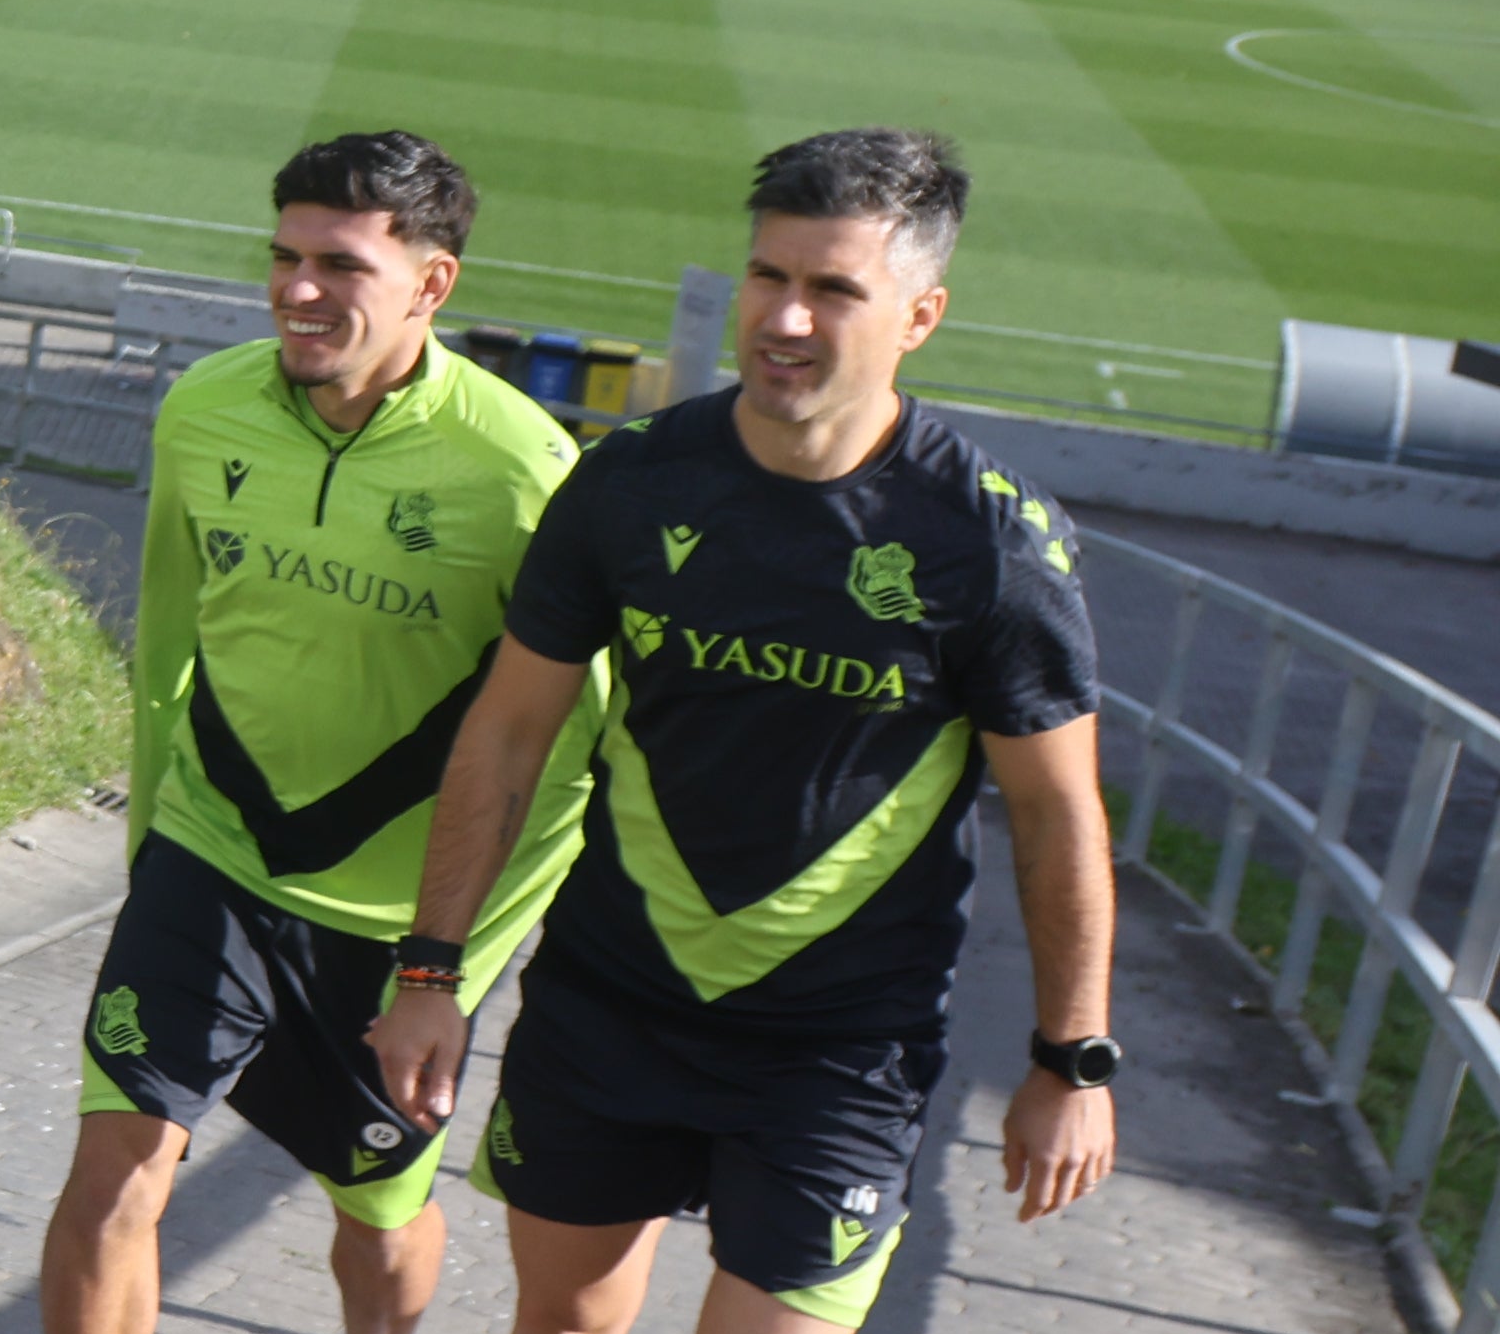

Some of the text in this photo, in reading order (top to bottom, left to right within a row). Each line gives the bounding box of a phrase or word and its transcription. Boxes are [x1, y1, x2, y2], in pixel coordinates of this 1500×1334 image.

[261, 543, 441, 619] YASUDA
[680, 627, 905, 699] YASUDA
[373, 1127, 394, 1143] 12
